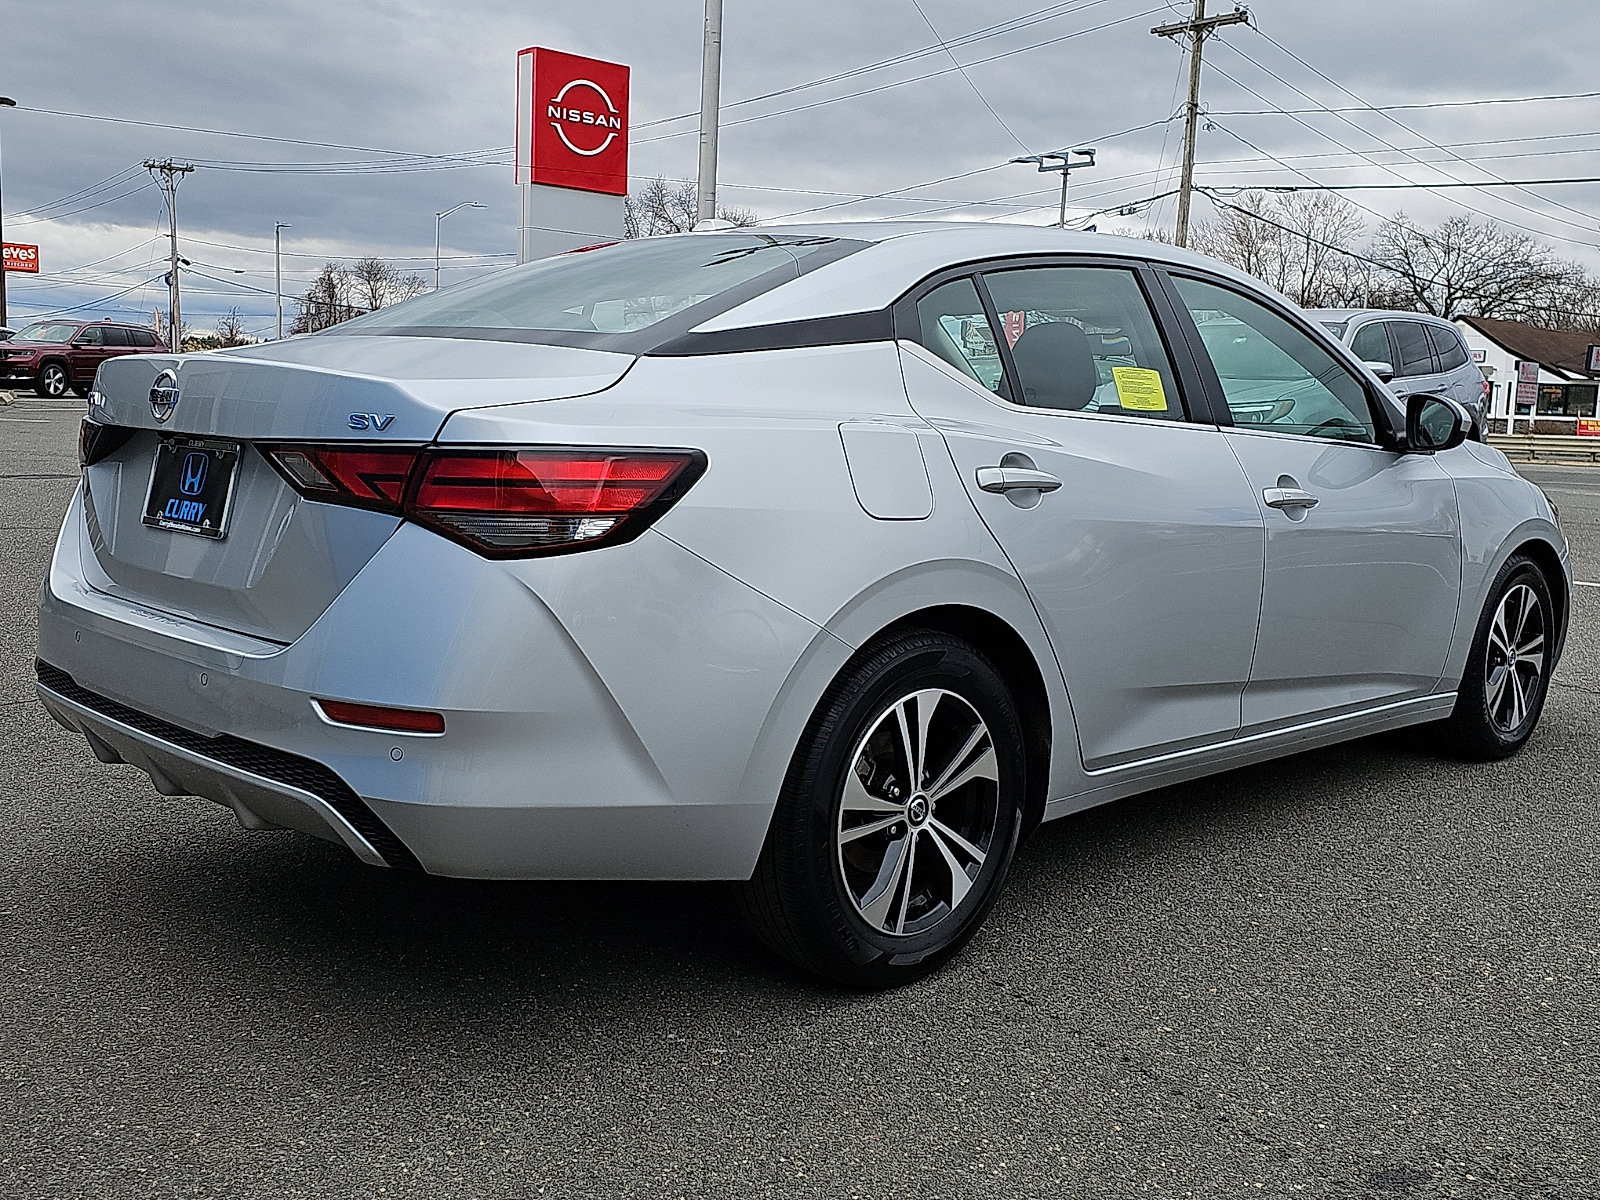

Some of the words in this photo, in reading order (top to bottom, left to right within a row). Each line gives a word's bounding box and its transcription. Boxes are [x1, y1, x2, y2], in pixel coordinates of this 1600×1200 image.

[547, 105, 621, 130] NISSAN
[347, 412, 396, 432] SV
[164, 498, 208, 523] CURRY
